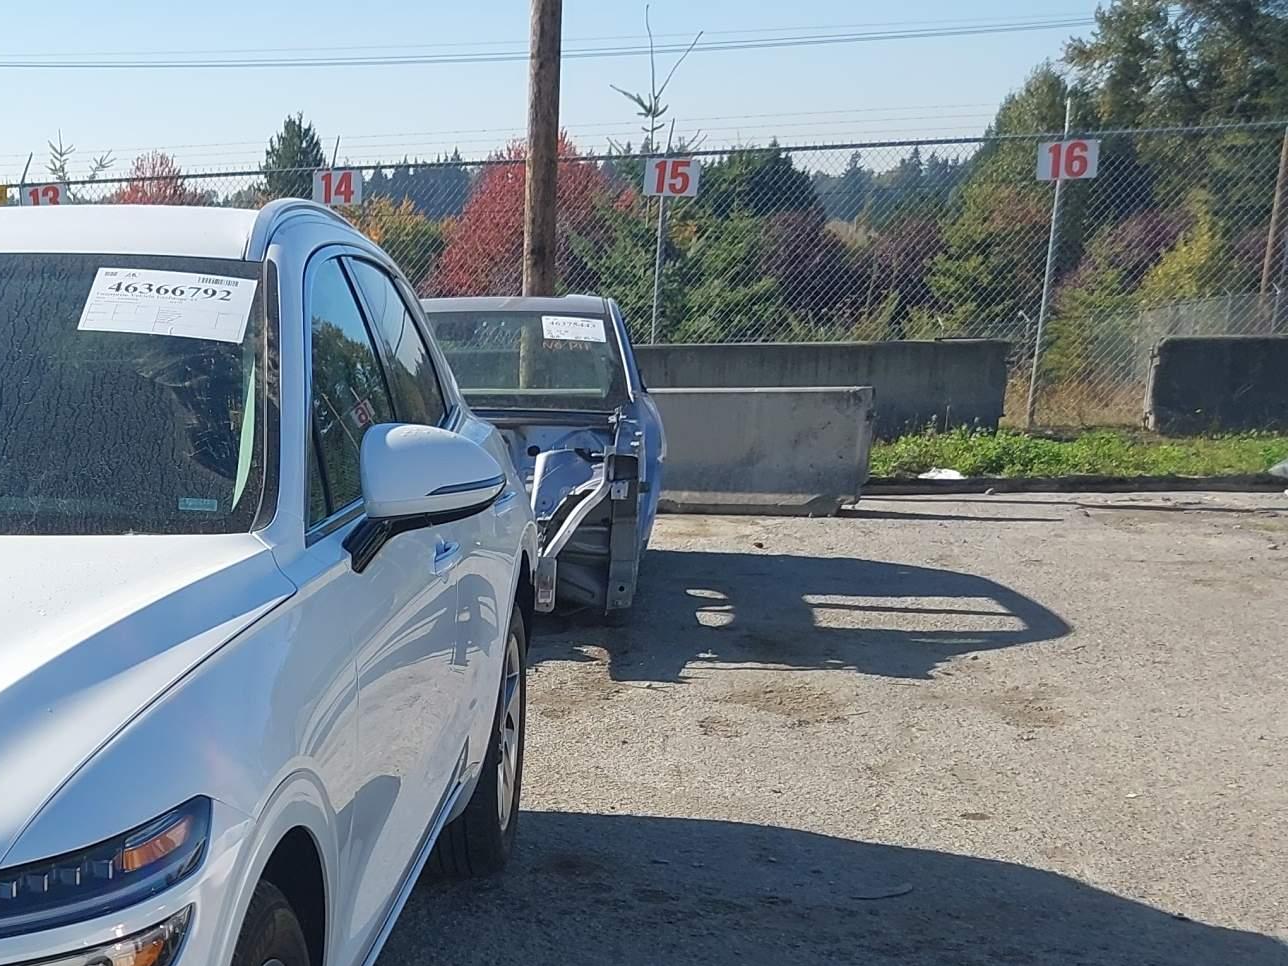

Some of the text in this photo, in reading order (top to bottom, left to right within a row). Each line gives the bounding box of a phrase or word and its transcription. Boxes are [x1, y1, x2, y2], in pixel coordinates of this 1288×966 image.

[1048, 142, 1089, 178] 16
[321, 172, 355, 204] 14
[655, 160, 691, 194] 15
[29, 186, 60, 205] 13
[108, 281, 233, 301] 46366792
